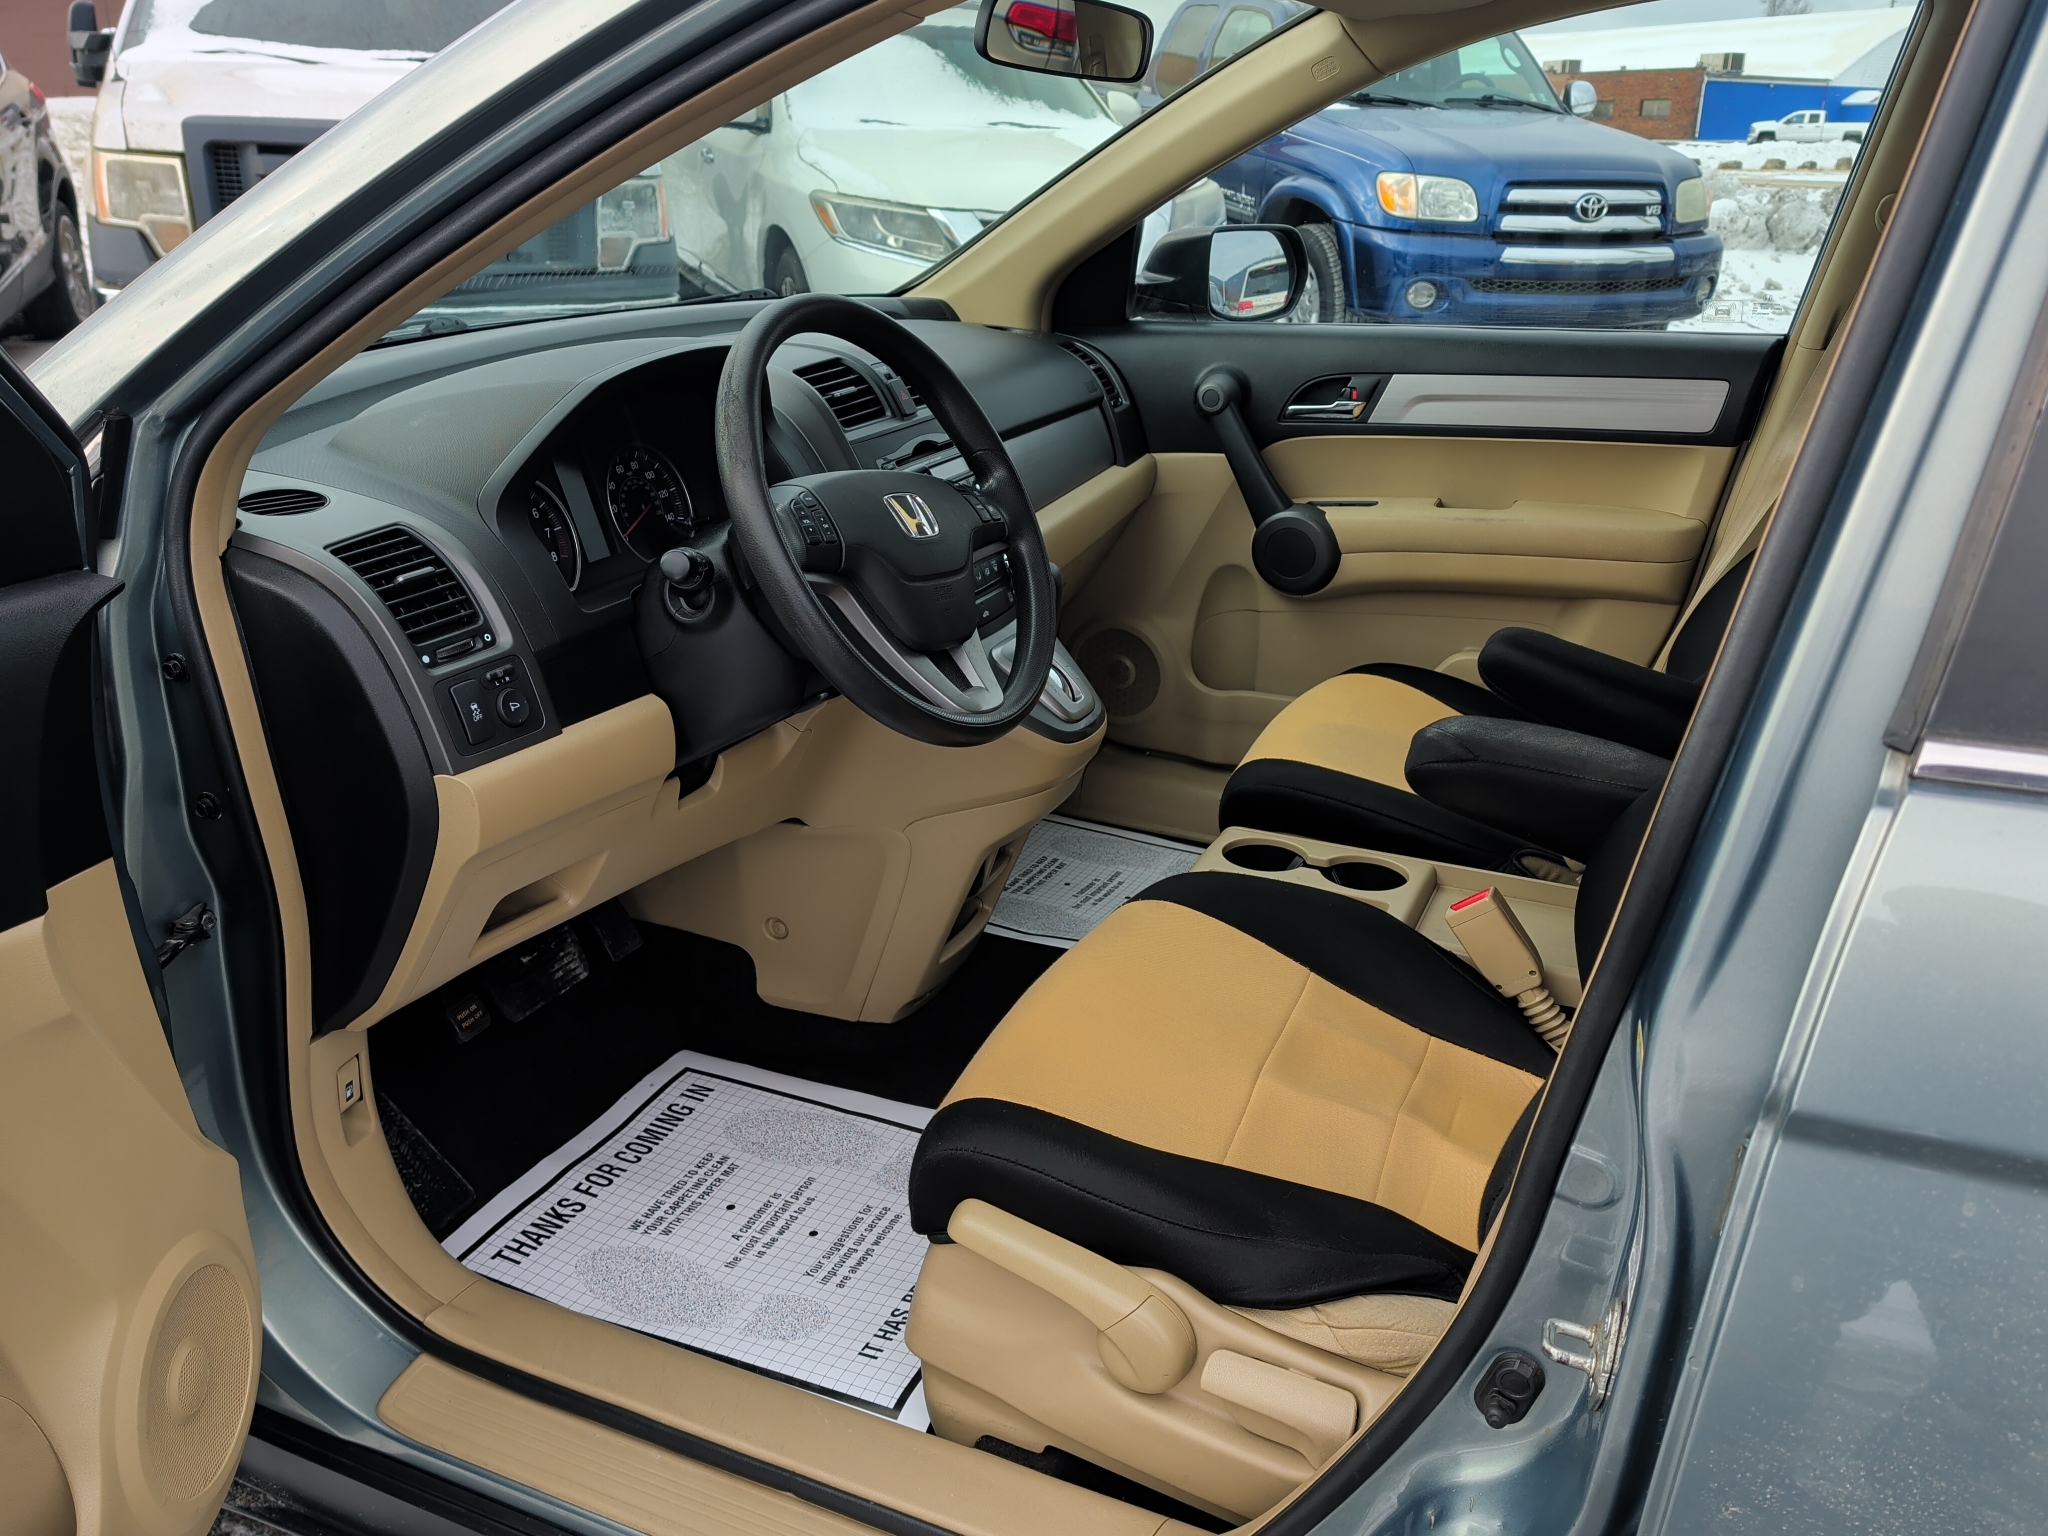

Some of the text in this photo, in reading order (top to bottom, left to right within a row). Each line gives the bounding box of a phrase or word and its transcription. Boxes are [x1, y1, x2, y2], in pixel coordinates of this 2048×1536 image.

[1646, 204, 1662, 216] V8
[616, 465, 624, 474] 60
[630, 461, 639, 470] 80
[645, 470, 655, 480] 100
[658, 489, 669, 498] 120
[532, 507, 540, 518] 6
[664, 512, 675, 522] 140
[544, 528, 550, 539] 7
[551, 551, 558, 562] 8
[473, 713, 483, 722] OFF
[456, 1004, 478, 1021] PUSH ON
[461, 1010, 483, 1029] PUSH OFF
[491, 1083, 715, 1265] THANKS FOR COMING IN
[628, 1152, 714, 1231] WE HAVE TRIED TO KEEP
[641, 1155, 730, 1236] YOUR CARPETING CLEAN
[659, 1162, 740, 1237] WITH THIS PAPER MAT
[724, 1176, 816, 1269] the most important person
[731, 1192, 782, 1242] A customer is
[752, 1195, 818, 1259] in the world to us.
[803, 1204, 874, 1278] Your suggestions for
[817, 1206, 891, 1286] improving our service
[835, 1212, 906, 1289] are always welcome.
[858, 1342, 884, 1360] IT
[873, 1308, 909, 1341] HAS
